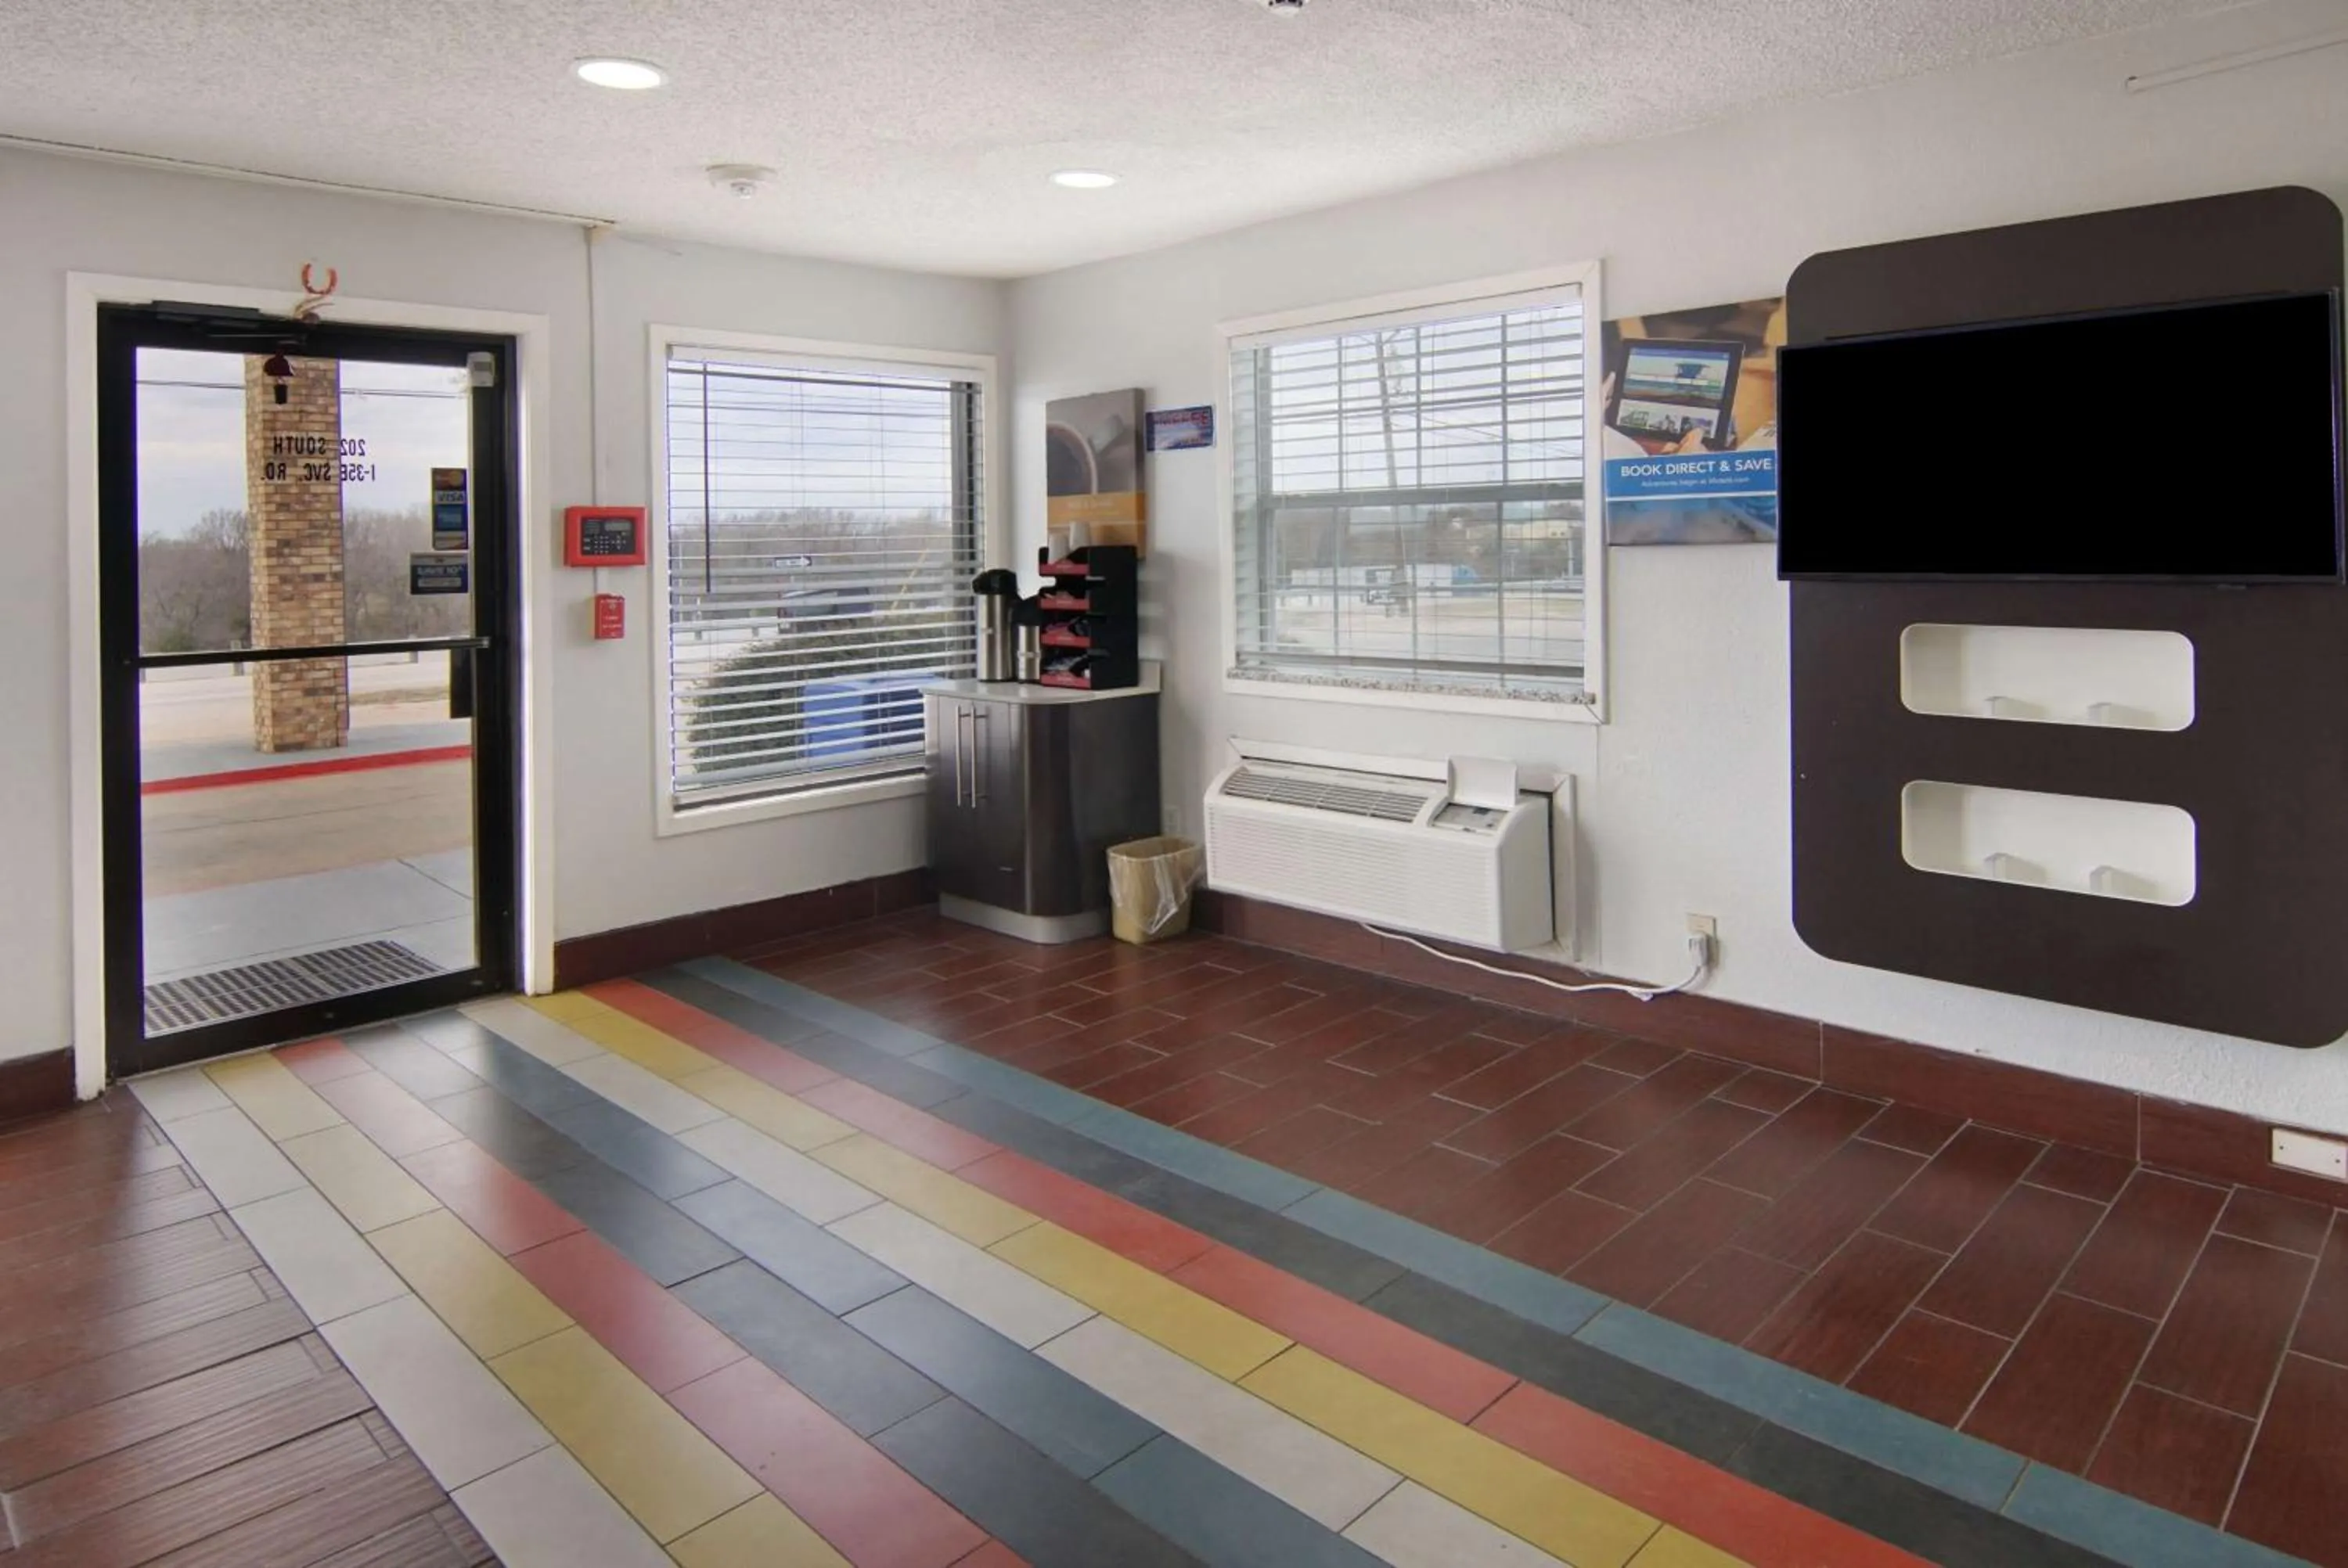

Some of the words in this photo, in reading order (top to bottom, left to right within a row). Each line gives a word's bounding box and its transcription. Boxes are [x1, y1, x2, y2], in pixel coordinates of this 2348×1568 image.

[1621, 464, 1662, 477] BOOK
[1666, 461, 1716, 475] DIRECT
[1720, 460, 1730, 472] &
[1734, 458, 1773, 470] SAVE
[438, 492, 463, 502] VISA
